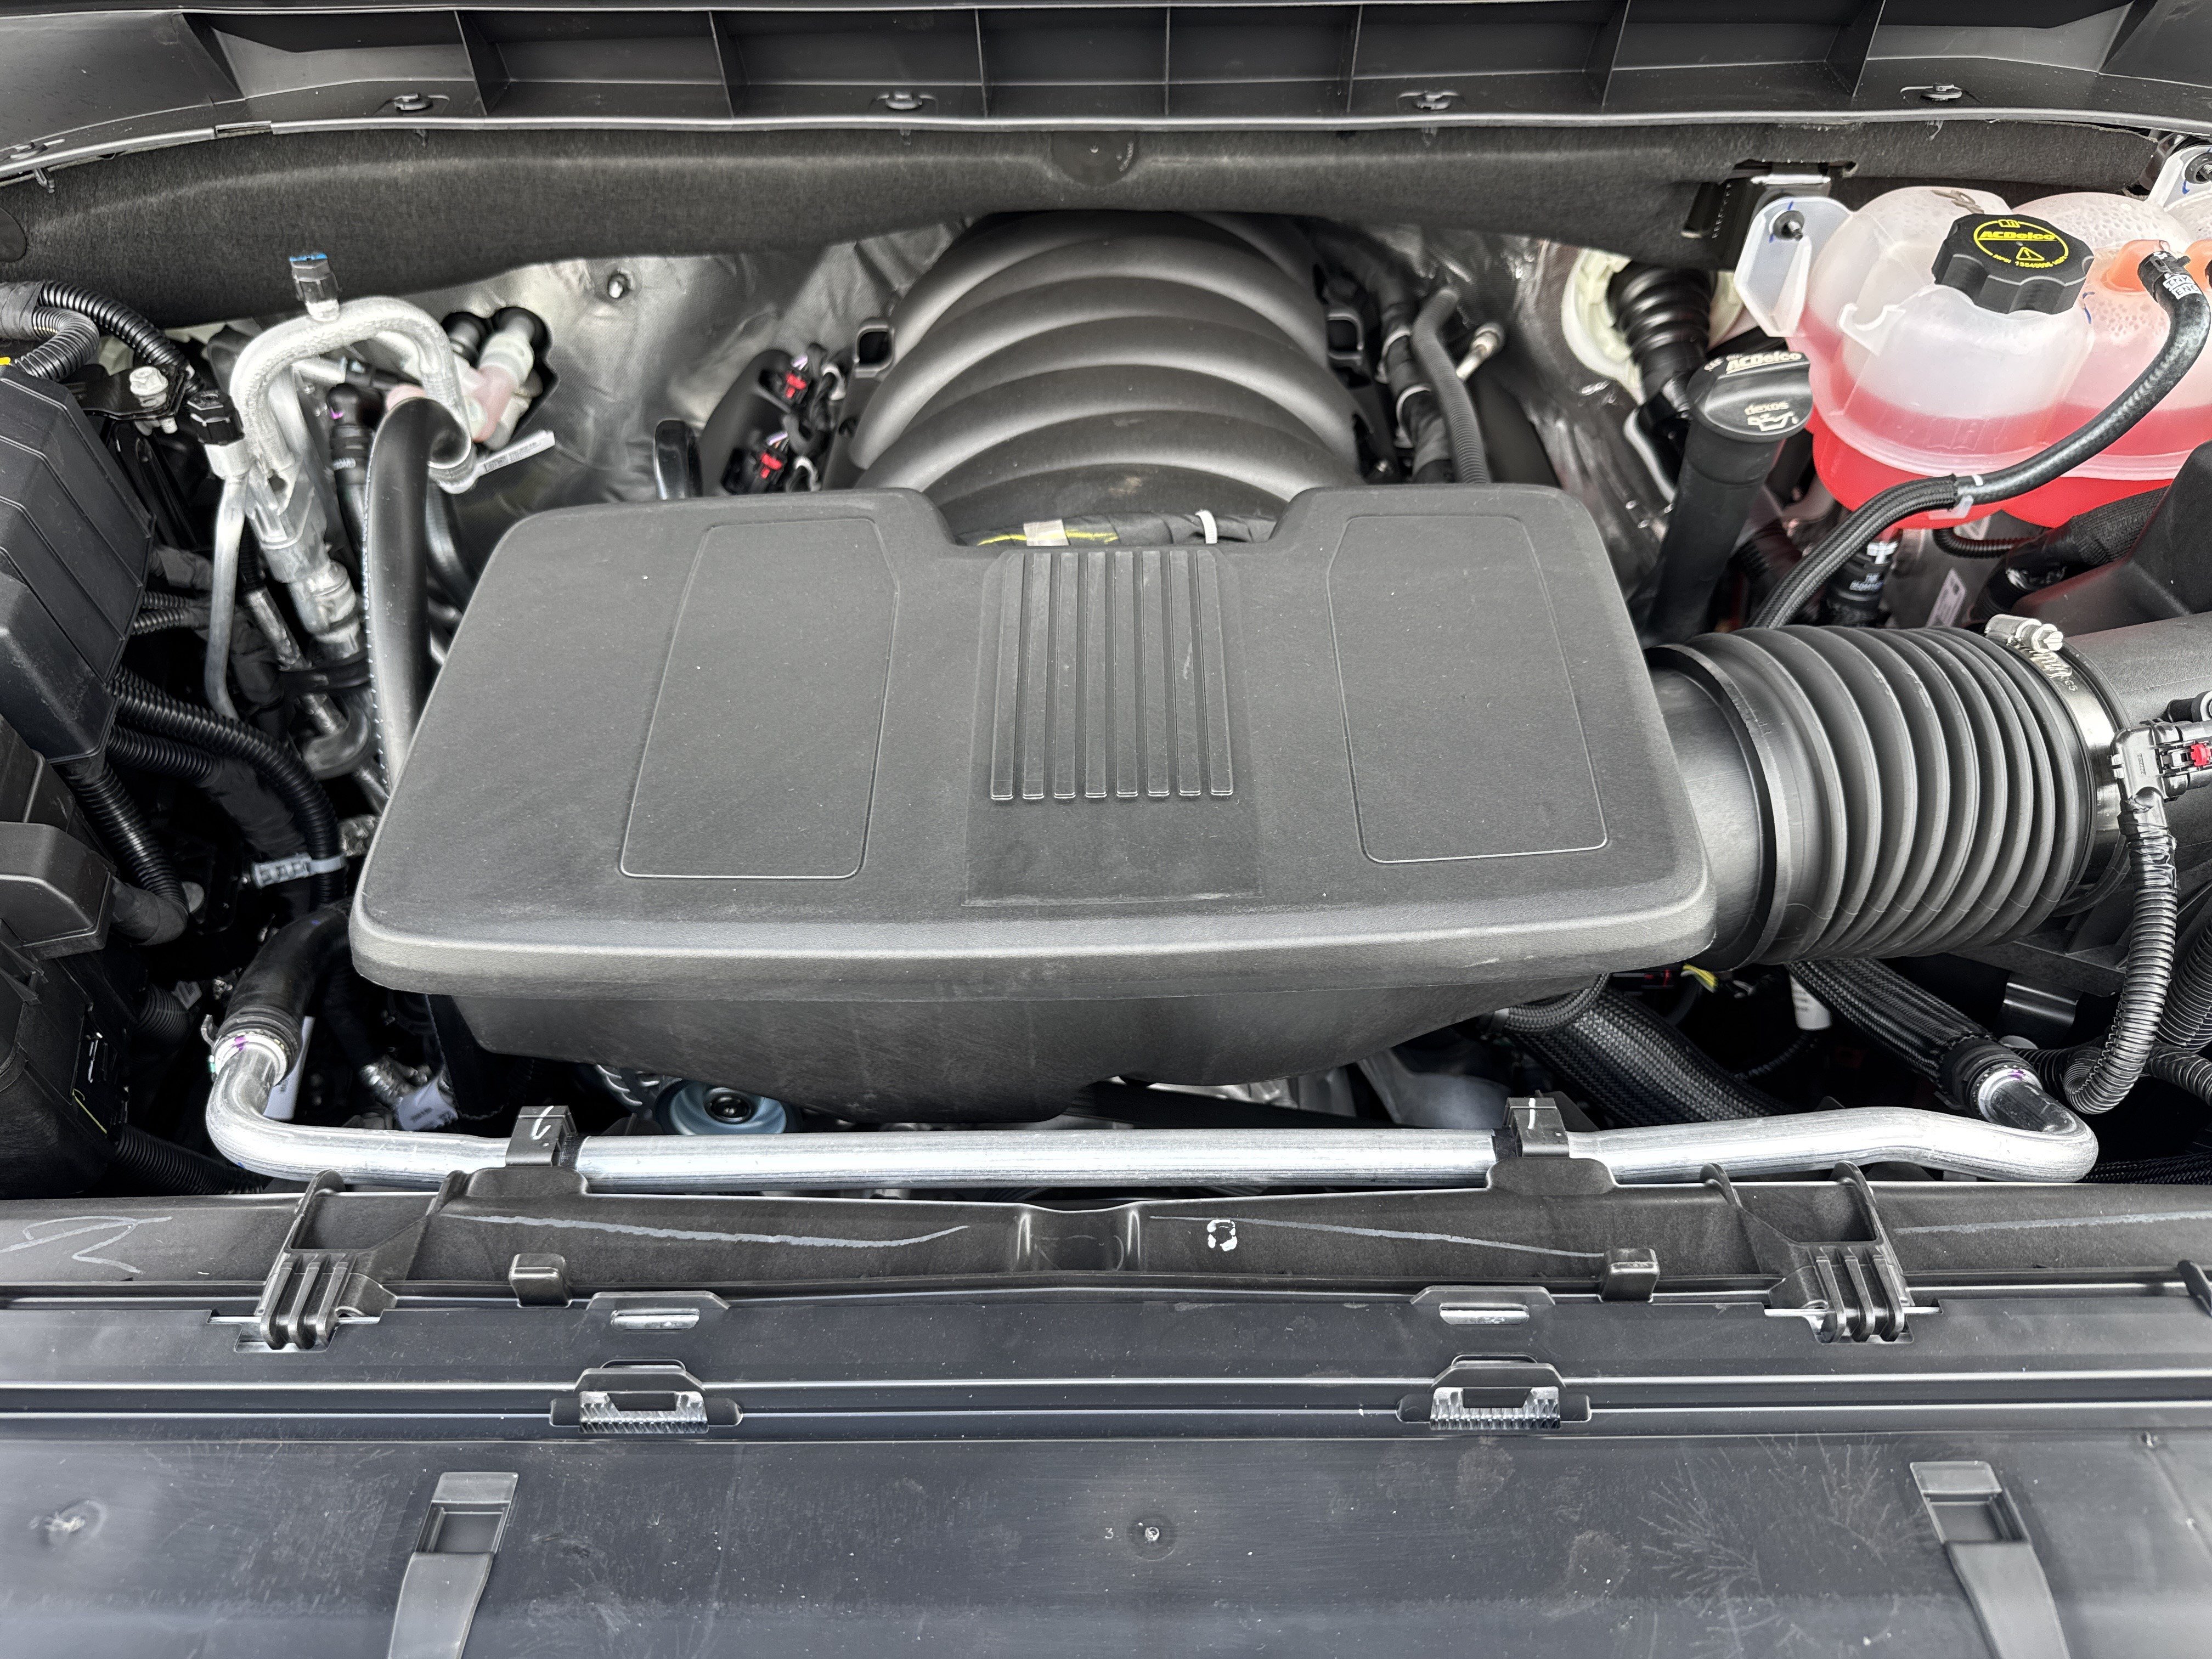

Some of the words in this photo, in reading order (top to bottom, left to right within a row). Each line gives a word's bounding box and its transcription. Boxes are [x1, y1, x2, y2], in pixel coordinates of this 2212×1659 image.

[1979, 230, 2056, 241] ACDelco
[1725, 351, 1803, 372] ACDelco
[1744, 401, 1791, 416] dexos
[1105, 1527, 1114, 1539] 3
